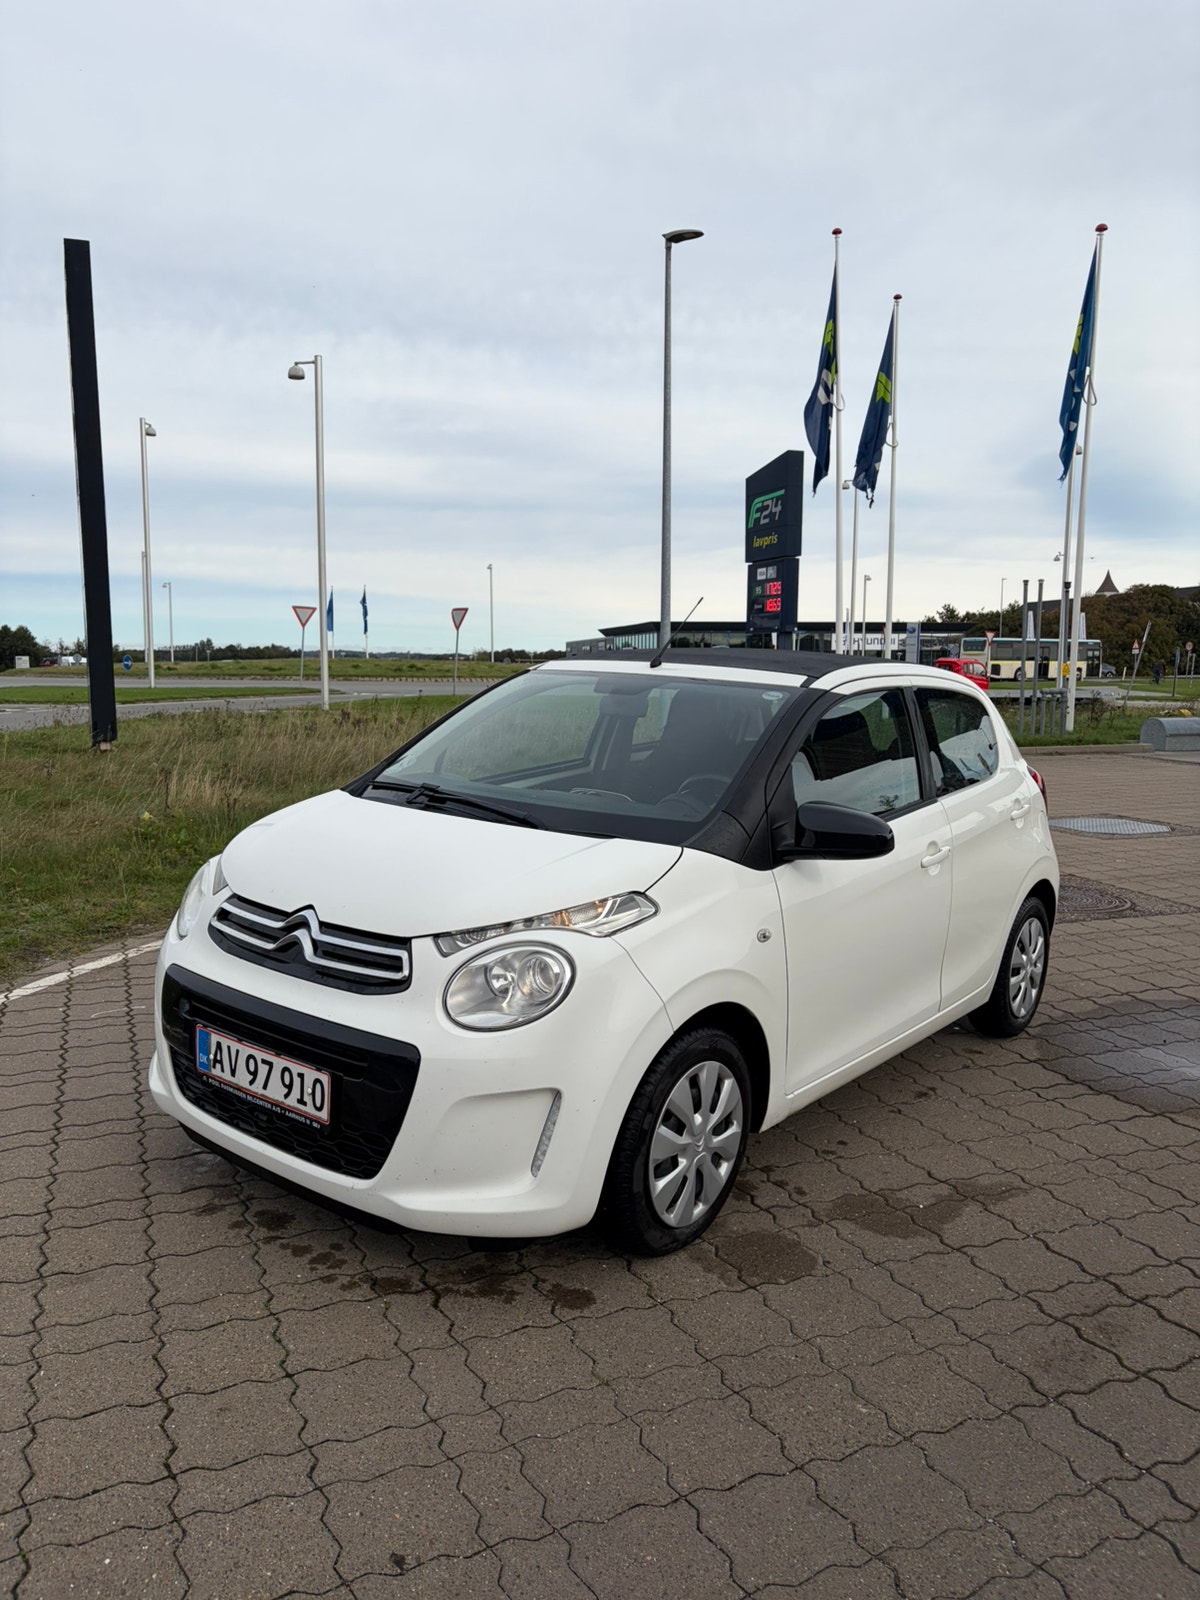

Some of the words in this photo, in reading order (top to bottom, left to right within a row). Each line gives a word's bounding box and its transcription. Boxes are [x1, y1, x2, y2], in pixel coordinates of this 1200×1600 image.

[748, 489, 785, 528] F24
[752, 532, 778, 548] lavpris
[212, 1040, 239, 1078] AV
[245, 1053, 274, 1091] 97
[280, 1066, 325, 1113] 910
